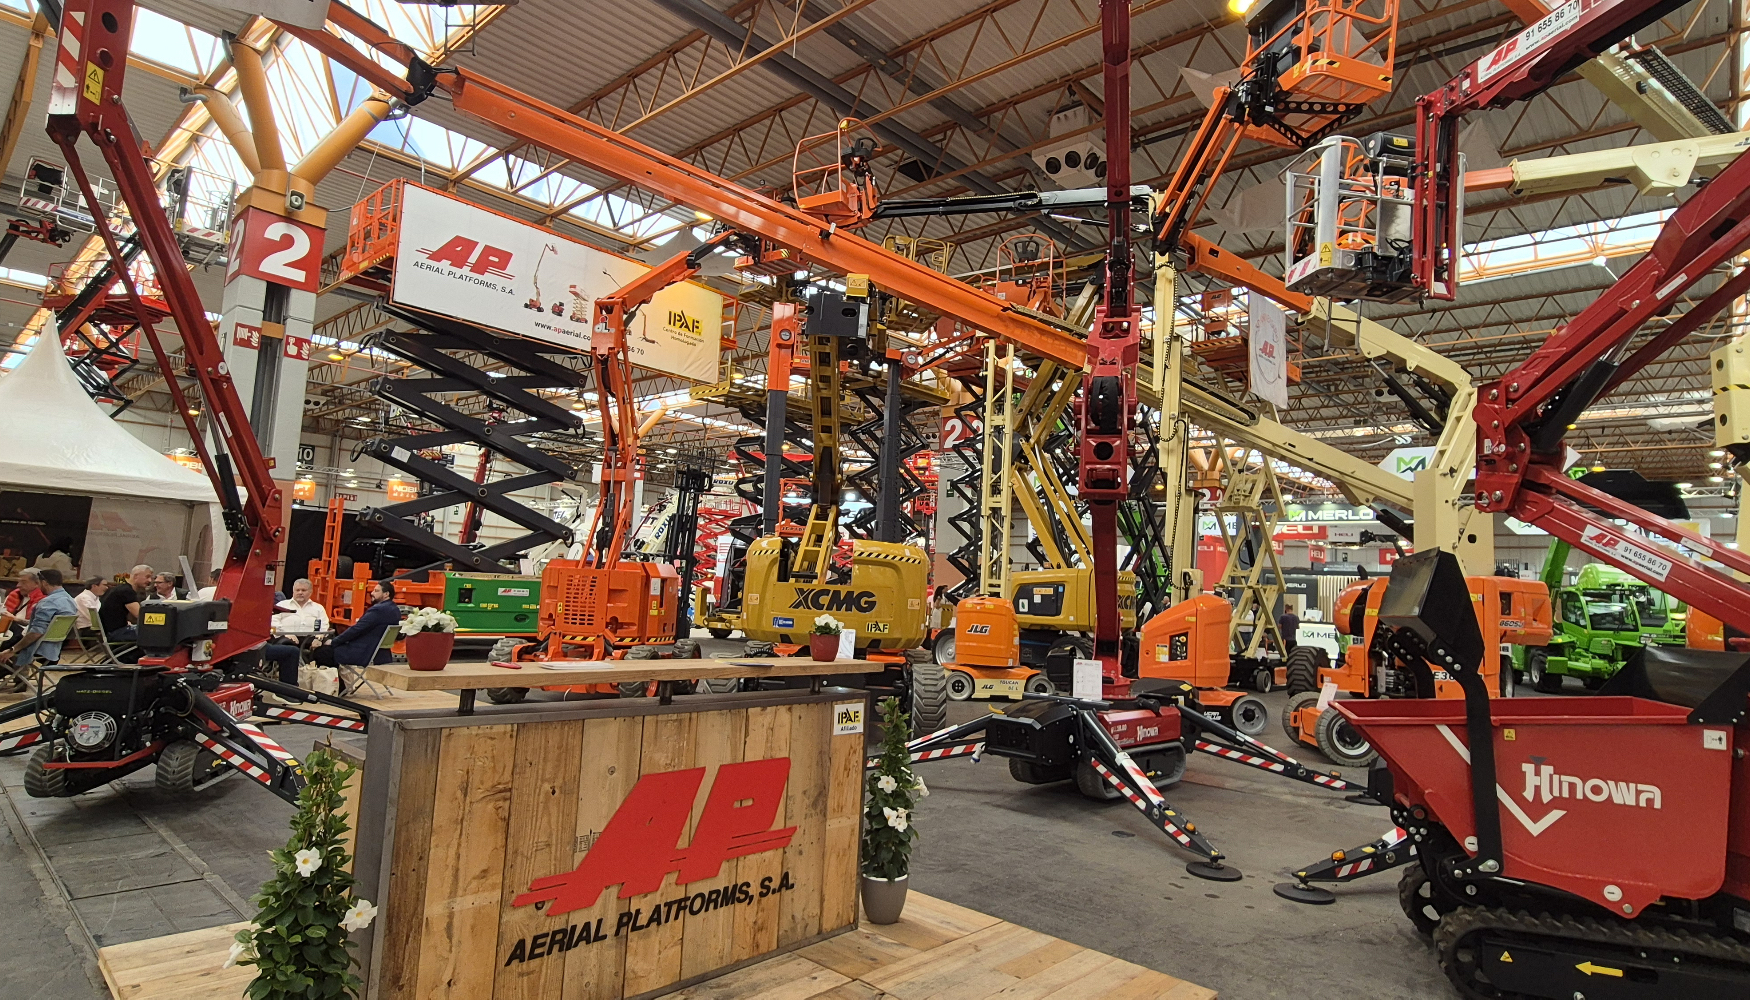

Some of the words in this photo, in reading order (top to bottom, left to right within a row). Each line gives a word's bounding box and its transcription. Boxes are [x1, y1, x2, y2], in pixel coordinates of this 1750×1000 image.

[1525, 30, 1536, 41] 91
[1537, 19, 1553, 33] 655
[1554, 10, 1565, 22] 86
[1567, 0, 1578, 14] 70
[1484, 38, 1519, 72] AP
[227, 218, 245, 277] 2
[258, 221, 311, 283] 2
[418, 235, 515, 279] AP
[413, 261, 445, 276] AERIAL
[447, 270, 500, 292] PLATFORMS,
[500, 286, 516, 296] S.A.
[534, 321, 591, 341] www.apaerial.co
[668, 310, 700, 333] IPAF
[636, 347, 645, 356] 70
[1260, 340, 1276, 359] AP
[943, 418, 963, 449] 2
[298, 447, 313, 462] 10
[713, 478, 734, 486] ROXU
[1307, 509, 1375, 521] MERLO
[1281, 525, 1319, 534] ELI
[1587, 532, 1621, 550] AP
[1310, 550, 1324, 559] HELI
[1623, 546, 1633, 555] 91
[1633, 551, 1646, 561] 655
[1657, 562, 1667, 571] 70
[788, 587, 877, 614] XCMG
[867, 620, 889, 632] IPAF
[967, 624, 989, 634] JLG
[838, 708, 860, 725] IPAF
[511, 757, 799, 917] AP
[504, 918, 608, 967] AERIAL
[614, 881, 755, 937] PLATFORMS,
[758, 871, 795, 898] S.A.
